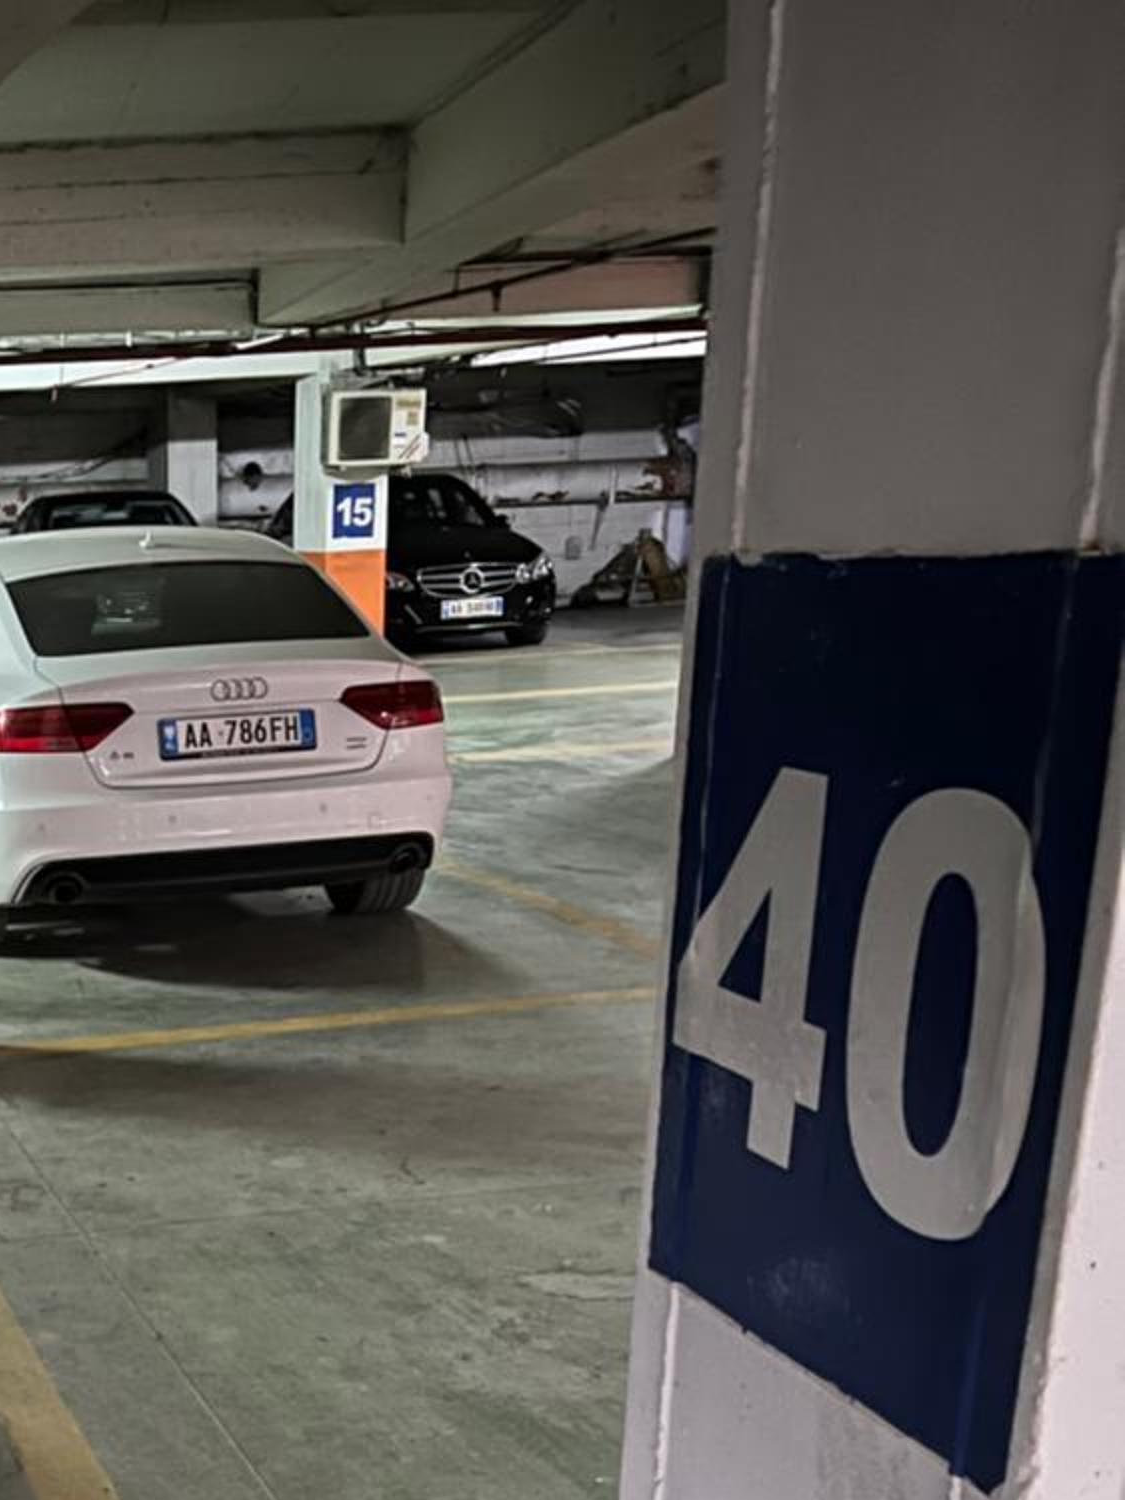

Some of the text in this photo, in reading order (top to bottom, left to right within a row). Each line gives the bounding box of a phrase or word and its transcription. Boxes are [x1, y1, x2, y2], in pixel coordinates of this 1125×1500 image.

[336, 496, 372, 527] 15
[184, 715, 300, 748] AA 786FH
[672, 766, 1046, 1241] 40
